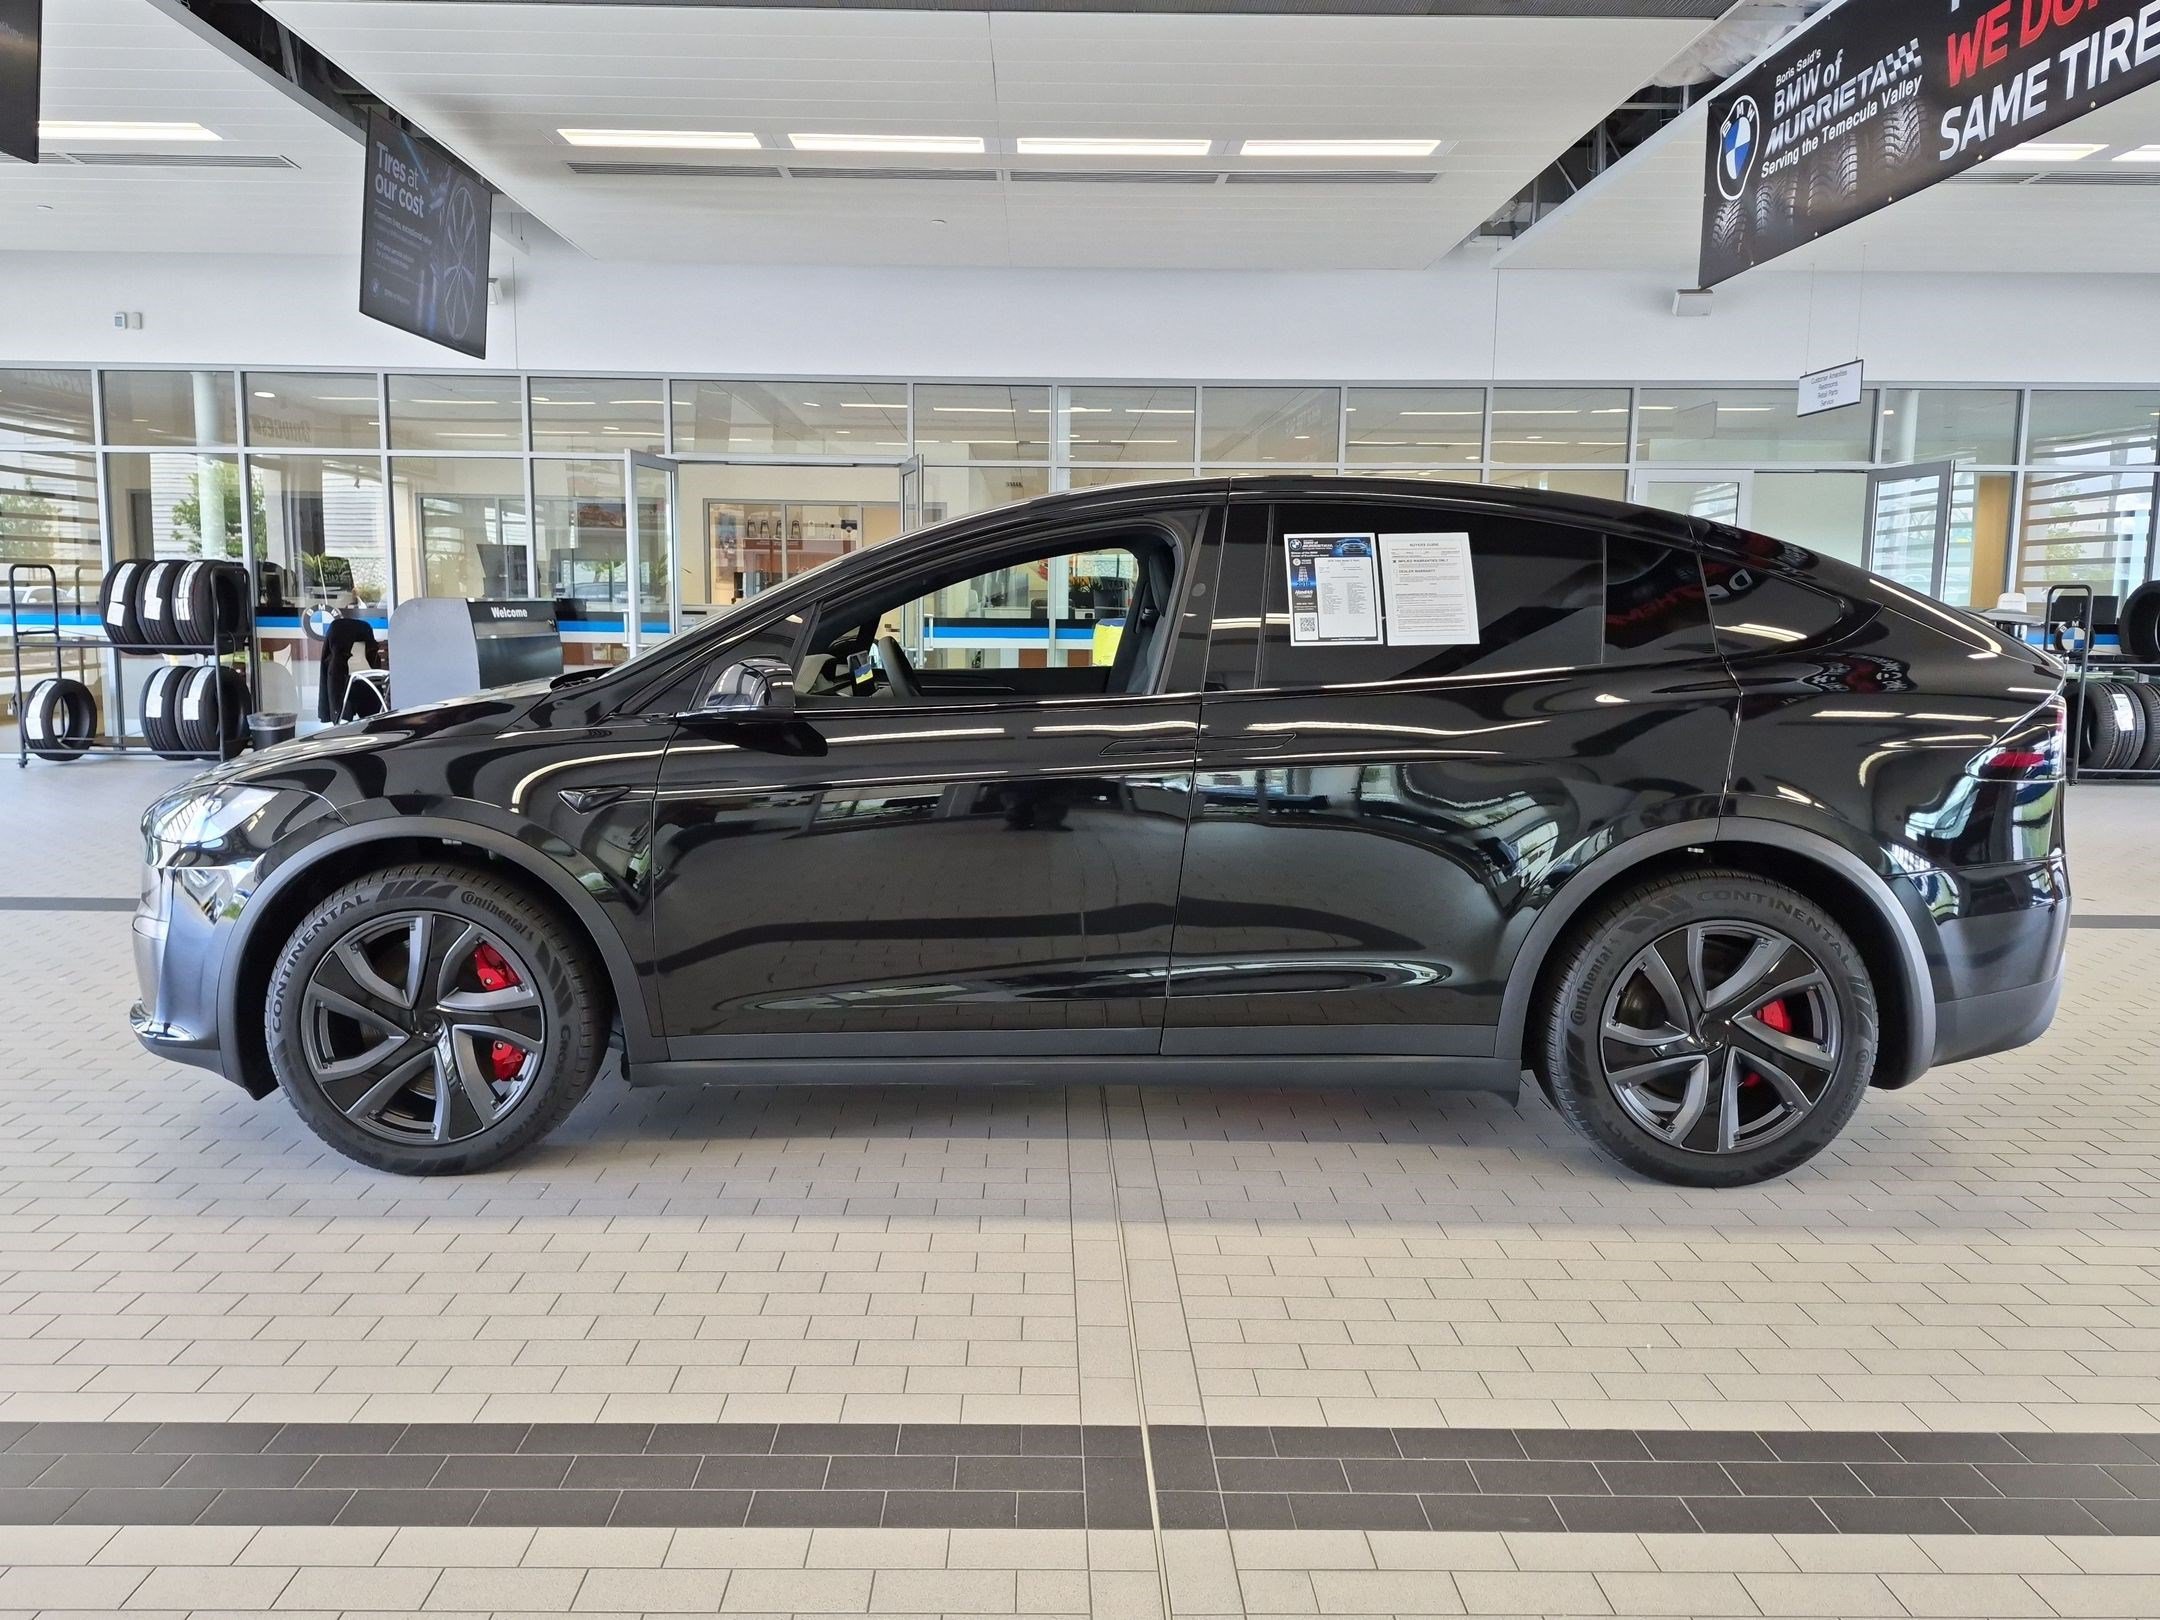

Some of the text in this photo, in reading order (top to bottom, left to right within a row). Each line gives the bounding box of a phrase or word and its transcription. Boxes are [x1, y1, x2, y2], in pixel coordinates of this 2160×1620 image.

[1775, 48, 1821, 87] Boris Said's
[1947, 0, 2011, 88] WE
[1763, 59, 1889, 159] MURRIETA
[1773, 48, 1844, 121] BMW of
[1939, 57, 2050, 161] SAME
[1760, 74, 1923, 178] Serving the Temecula Valley
[375, 174, 424, 218] our cost
[376, 141, 419, 191] Tires at
[491, 607, 528, 618] Welcome
[461, 890, 529, 935] Continental
[1696, 889, 1850, 969] CONTINENTAL
[272, 895, 370, 1033] CONTINENTAL
